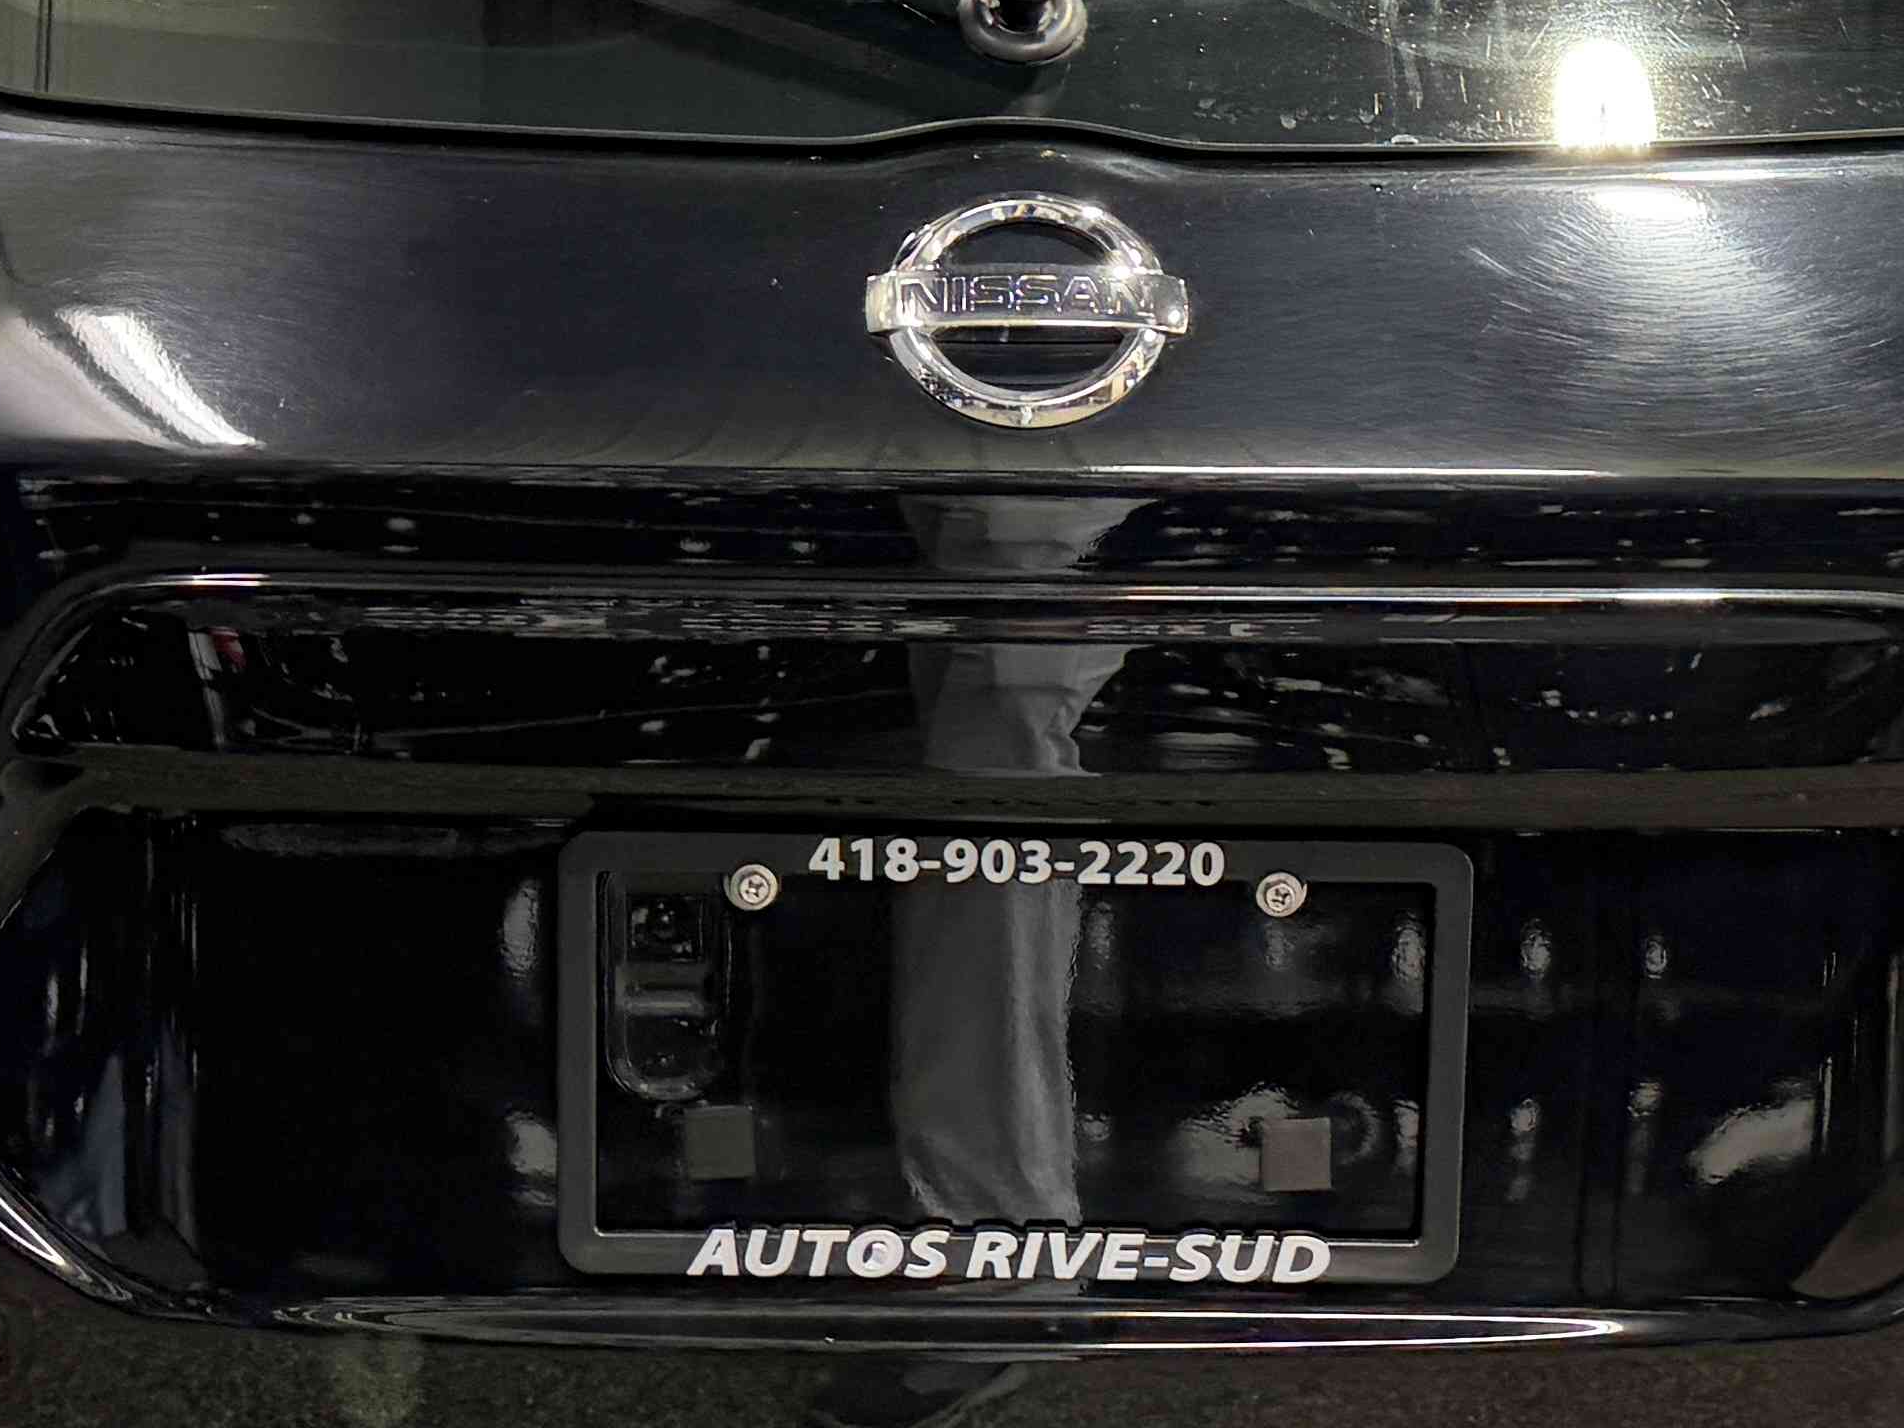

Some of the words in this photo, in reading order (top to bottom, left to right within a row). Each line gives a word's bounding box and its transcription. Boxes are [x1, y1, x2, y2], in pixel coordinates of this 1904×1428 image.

[899, 274, 1156, 320] NISSAN
[808, 836, 1226, 888] 418-903-2220
[685, 1227, 952, 1280] AUTOS
[965, 1229, 1332, 1284] RIVE-SUD
